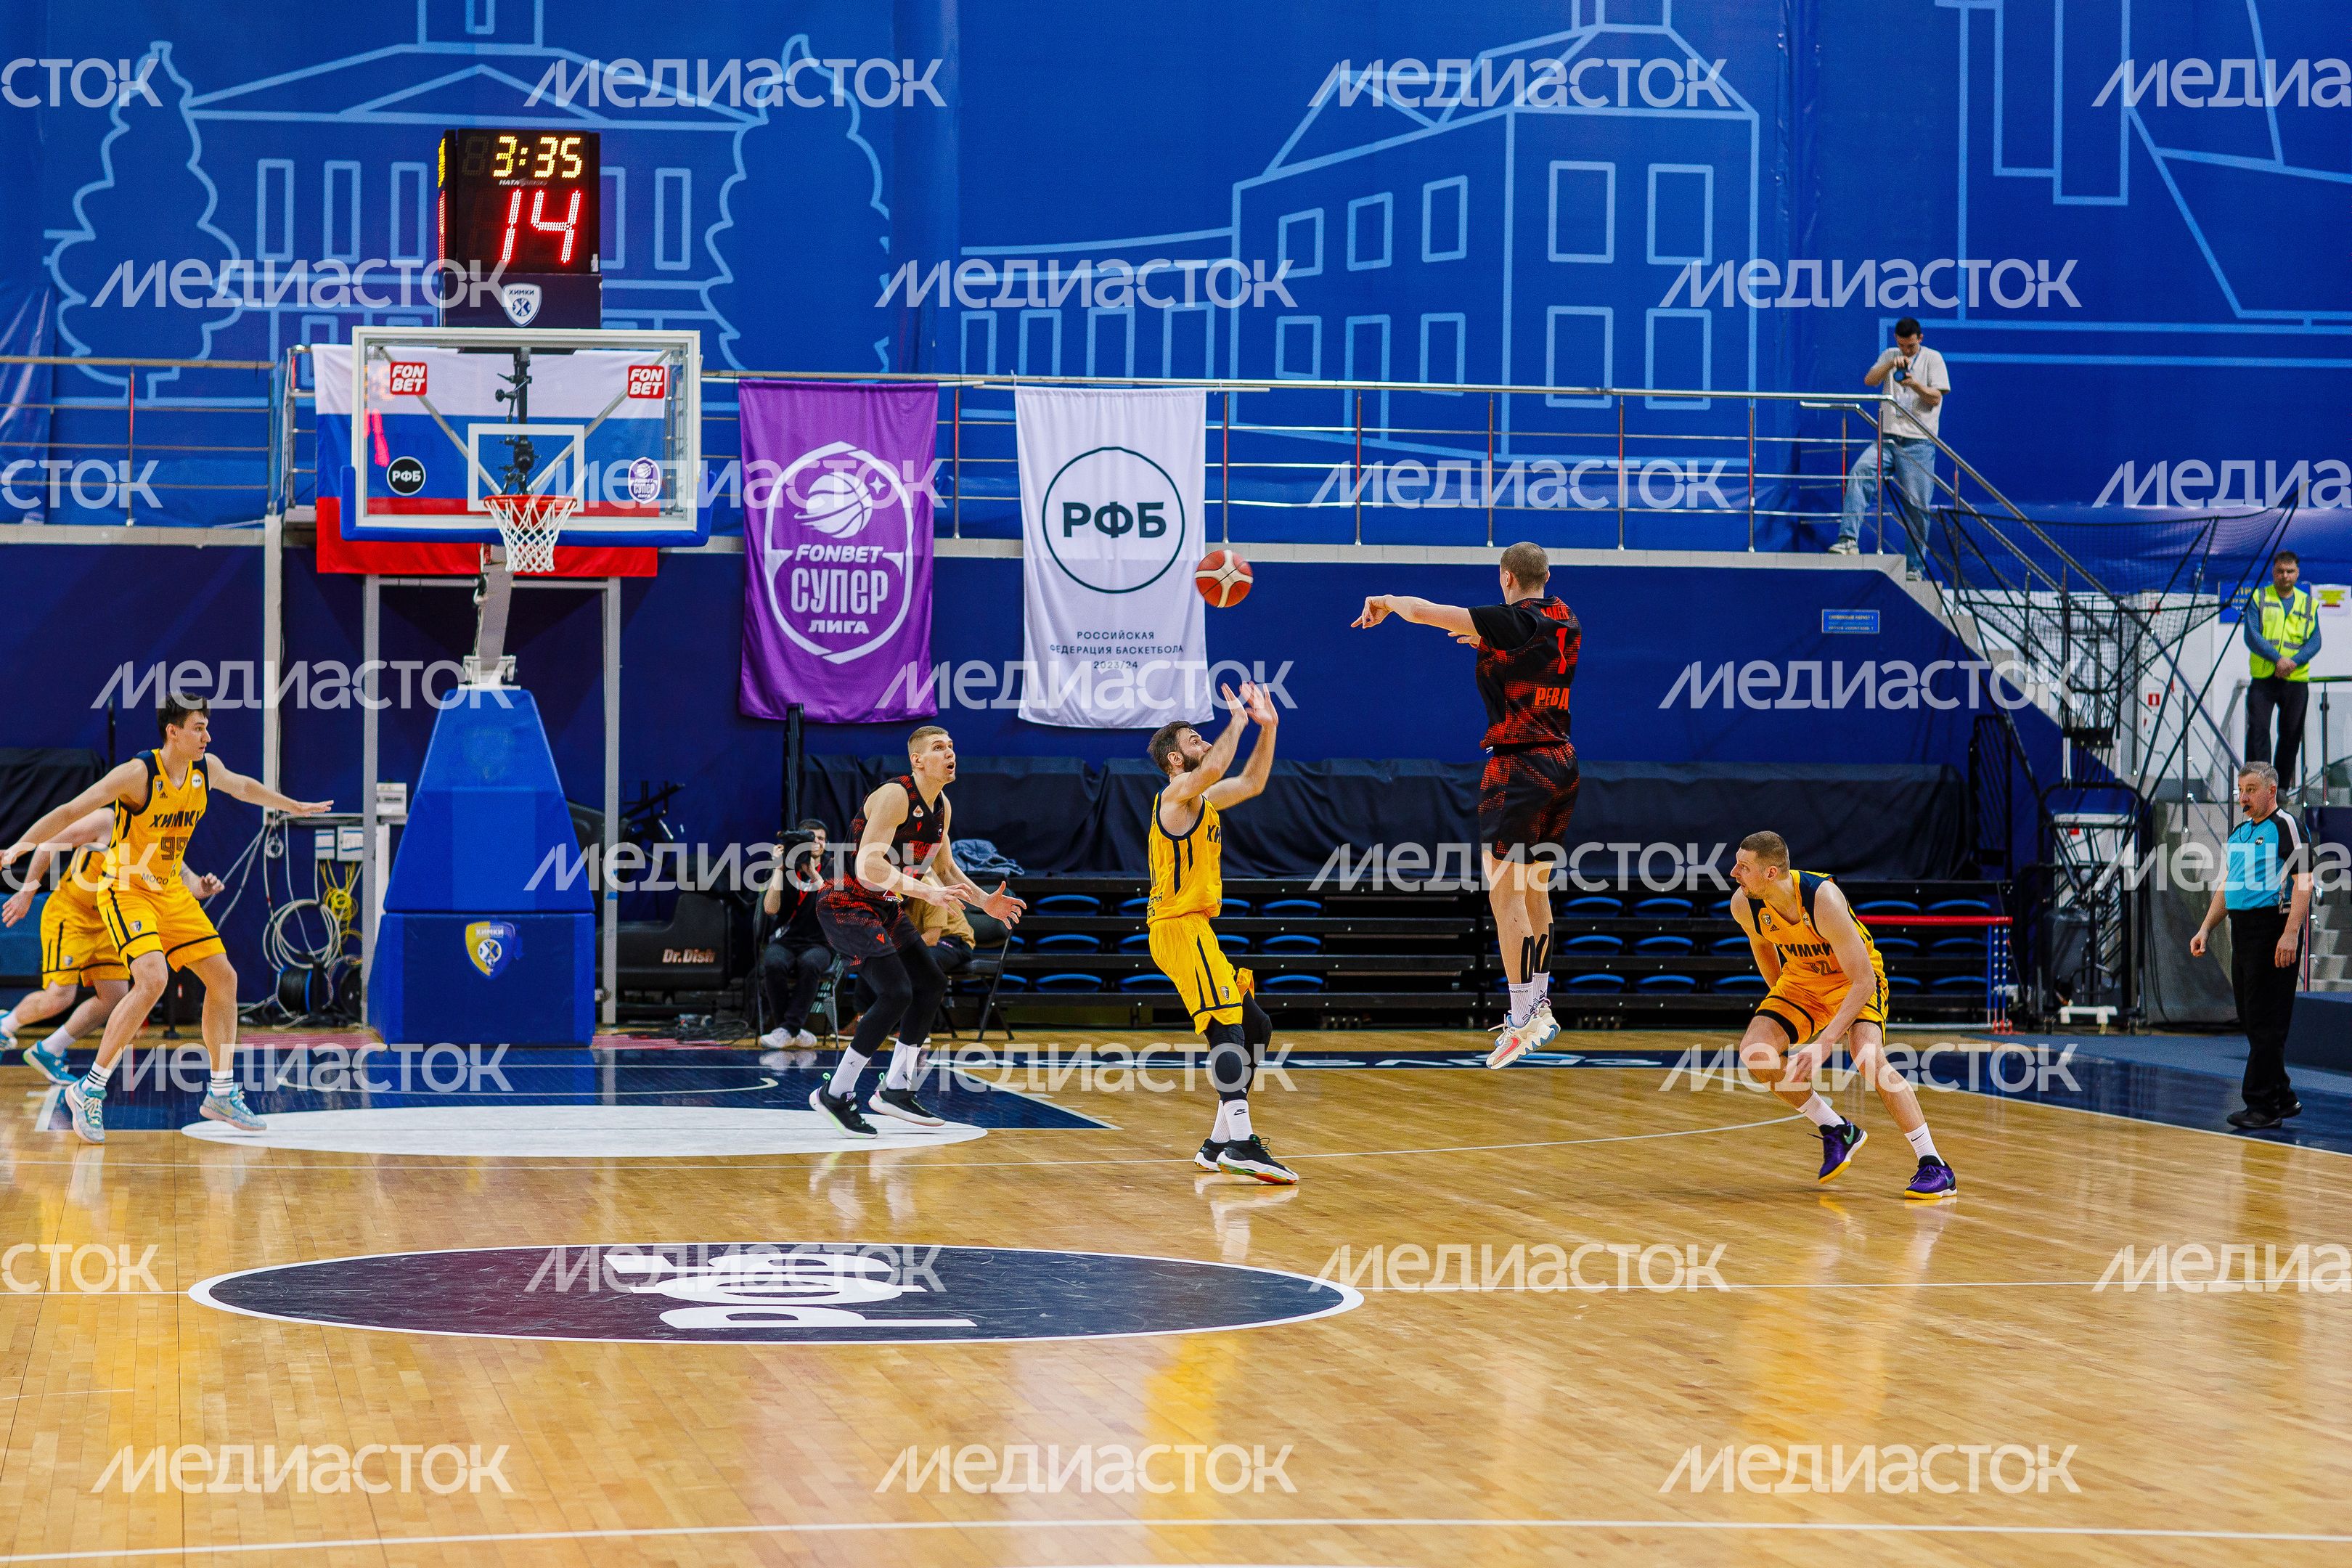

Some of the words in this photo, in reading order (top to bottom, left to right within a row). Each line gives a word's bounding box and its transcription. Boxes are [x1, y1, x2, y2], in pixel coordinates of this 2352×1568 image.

[493, 136, 582, 178] 3:35
[502, 189, 581, 263] 14
[392, 364, 426, 379] FON
[629, 368, 663, 382] FON
[391, 377, 425, 393] BET
[629, 381, 663, 395] BET
[392, 470, 421, 482] РФБ
[1063, 501, 1167, 539] РФБ
[795, 544, 883, 563] FONBET
[808, 620, 870, 634] ЛИГА
[1077, 630, 1154, 640] РОССИЙСКАЯ
[1050, 645, 1111, 656] ФЕДЕРАЦИЯ
[1116, 645, 1183, 655] БАСКЕТБОЛА
[1556, 627, 1568, 674] 1
